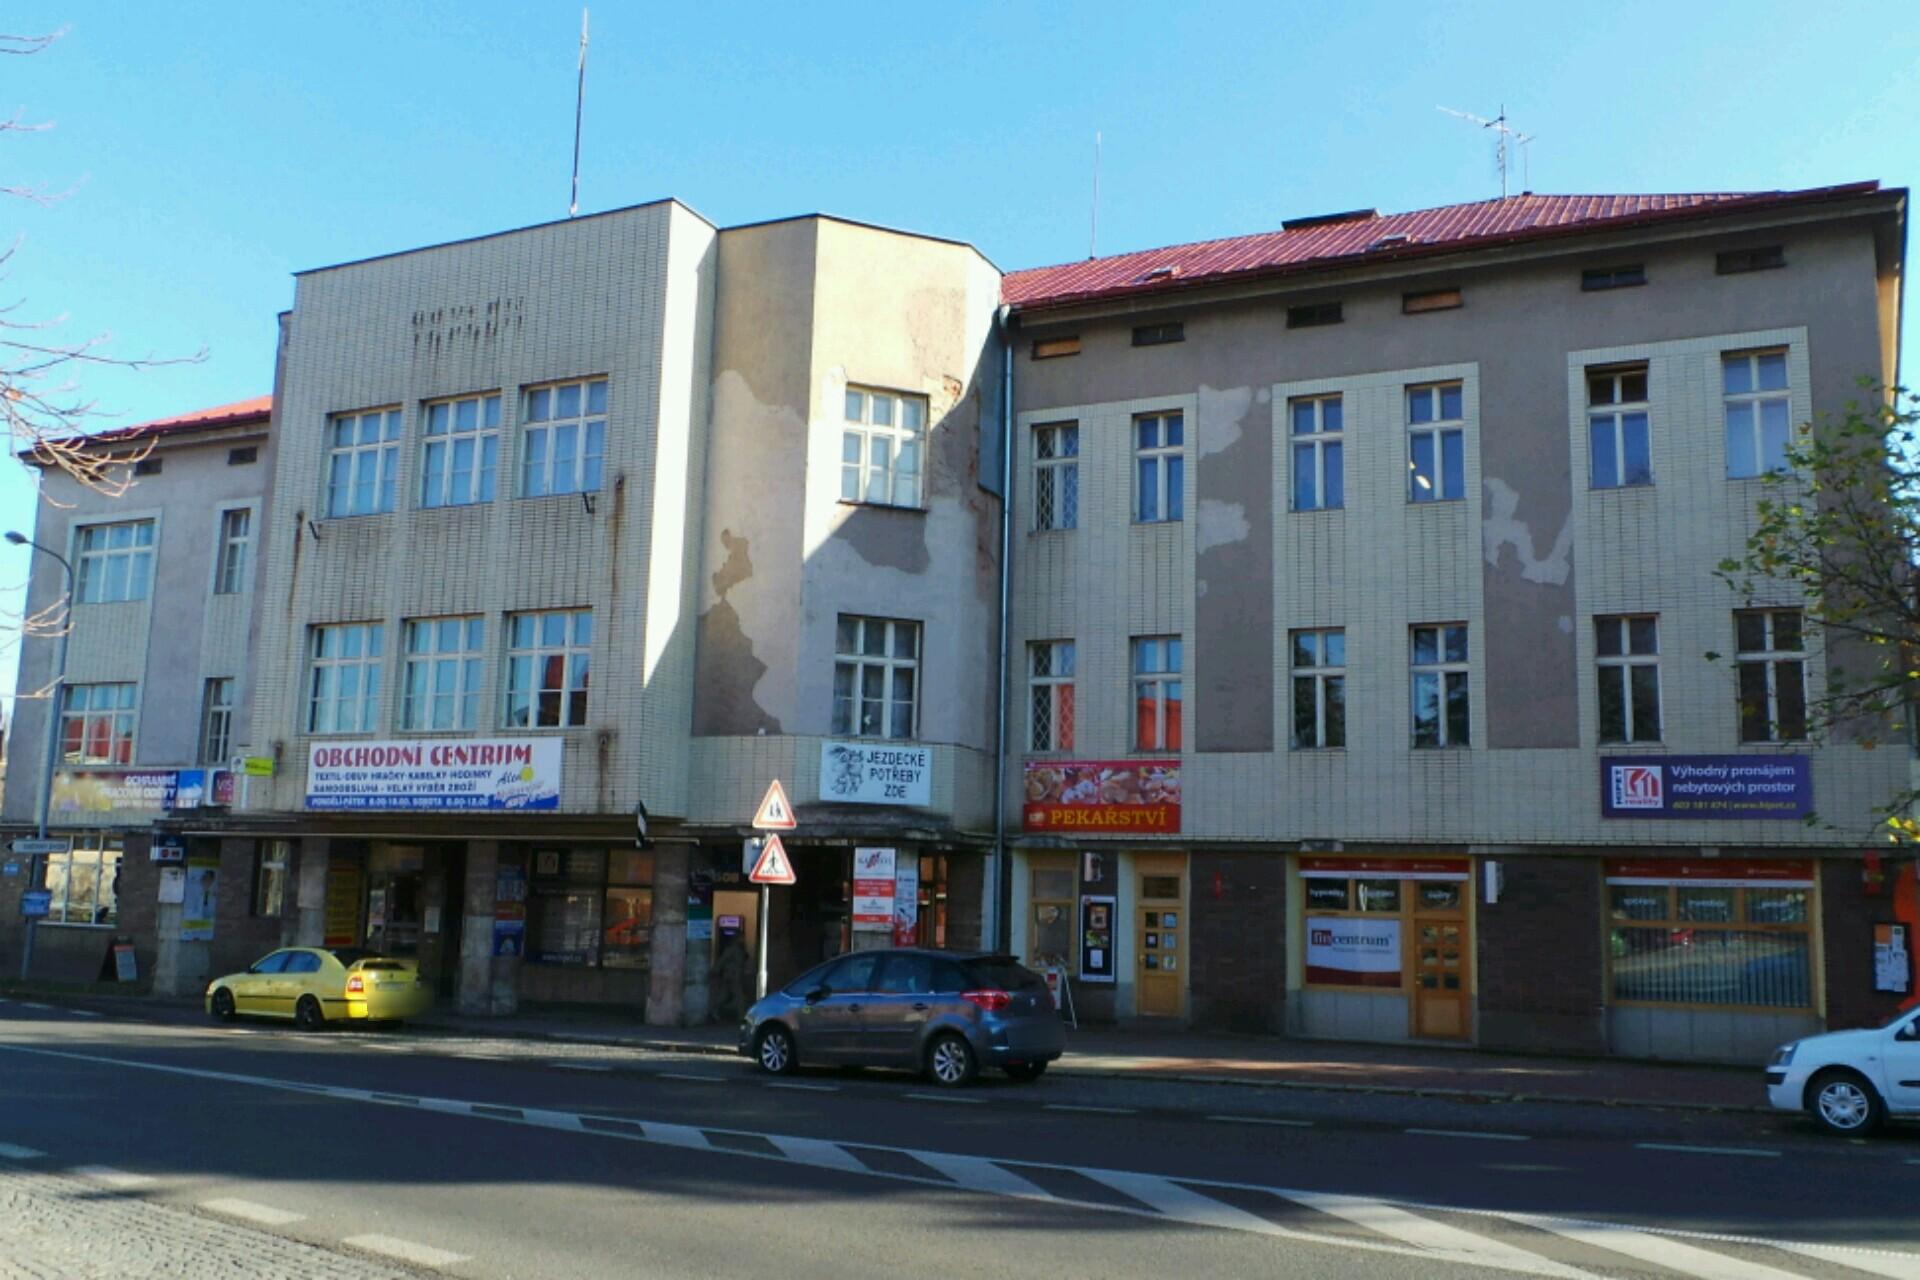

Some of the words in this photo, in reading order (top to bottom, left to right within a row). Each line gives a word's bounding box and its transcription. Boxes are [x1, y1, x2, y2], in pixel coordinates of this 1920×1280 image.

[314, 743, 422, 767] OBCHODNÍ
[430, 744, 532, 766] CENTRUM
[867, 751, 925, 767] JEZDECKÉ
[870, 766, 921, 782] POTŘEBY
[1671, 765, 1728, 779] Výhodný
[1731, 766, 1795, 779] pronájem
[884, 784, 906, 798] ZDE
[1673, 782, 1745, 795] nebytových
[1748, 782, 1797, 795] prostor
[1051, 806, 1168, 826] PEKAŘSTVÍ
[1311, 931, 1390, 947] fincentrum
